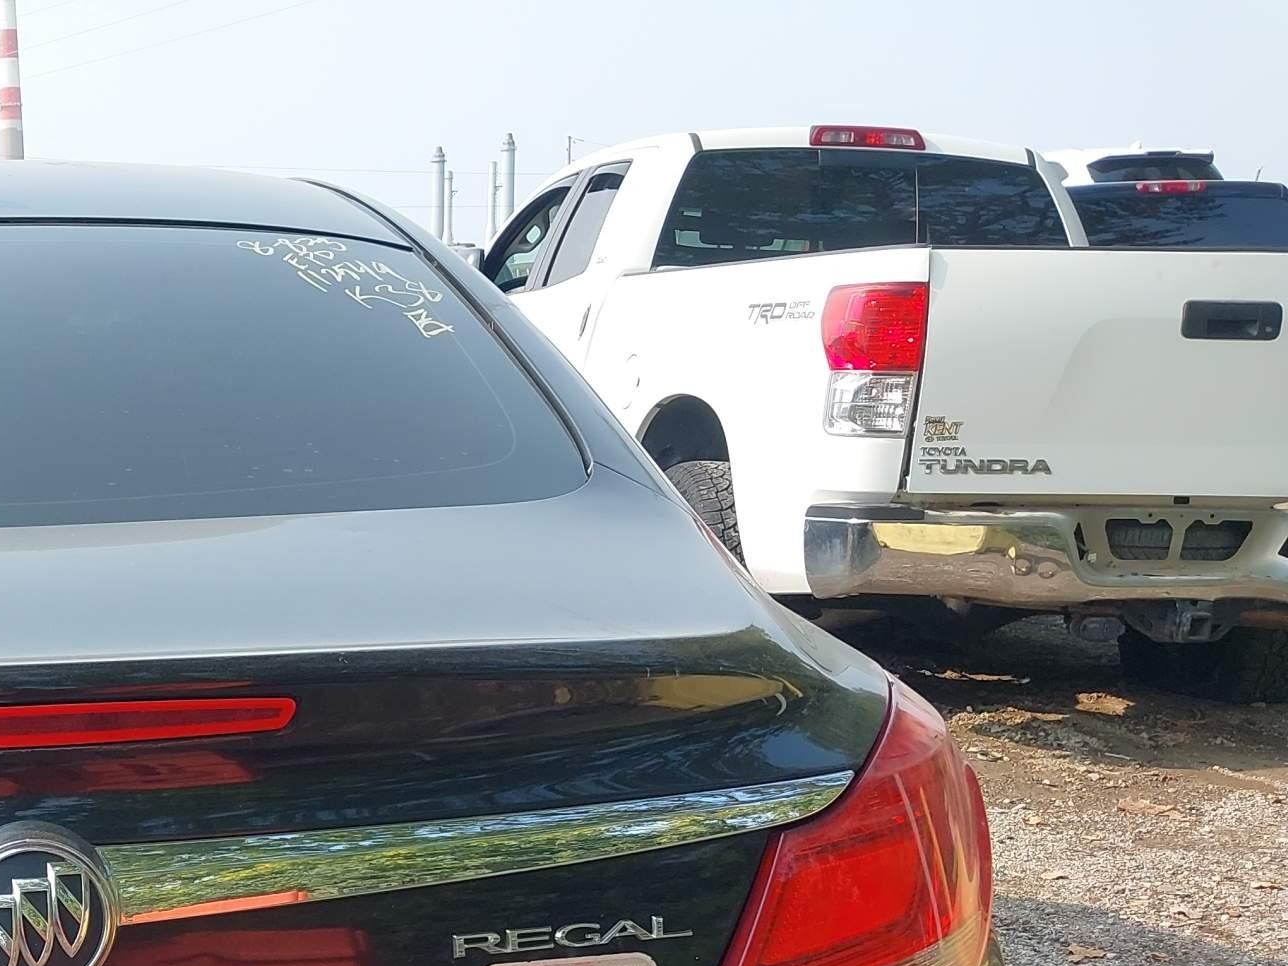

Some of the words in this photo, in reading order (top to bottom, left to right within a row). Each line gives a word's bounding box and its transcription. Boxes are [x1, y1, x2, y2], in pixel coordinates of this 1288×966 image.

[748, 302, 787, 325] TRD
[923, 421, 964, 436] KENT
[920, 446, 967, 457] TOYOTA
[918, 458, 1053, 476] TUNDRA
[451, 915, 694, 959] REGAL
